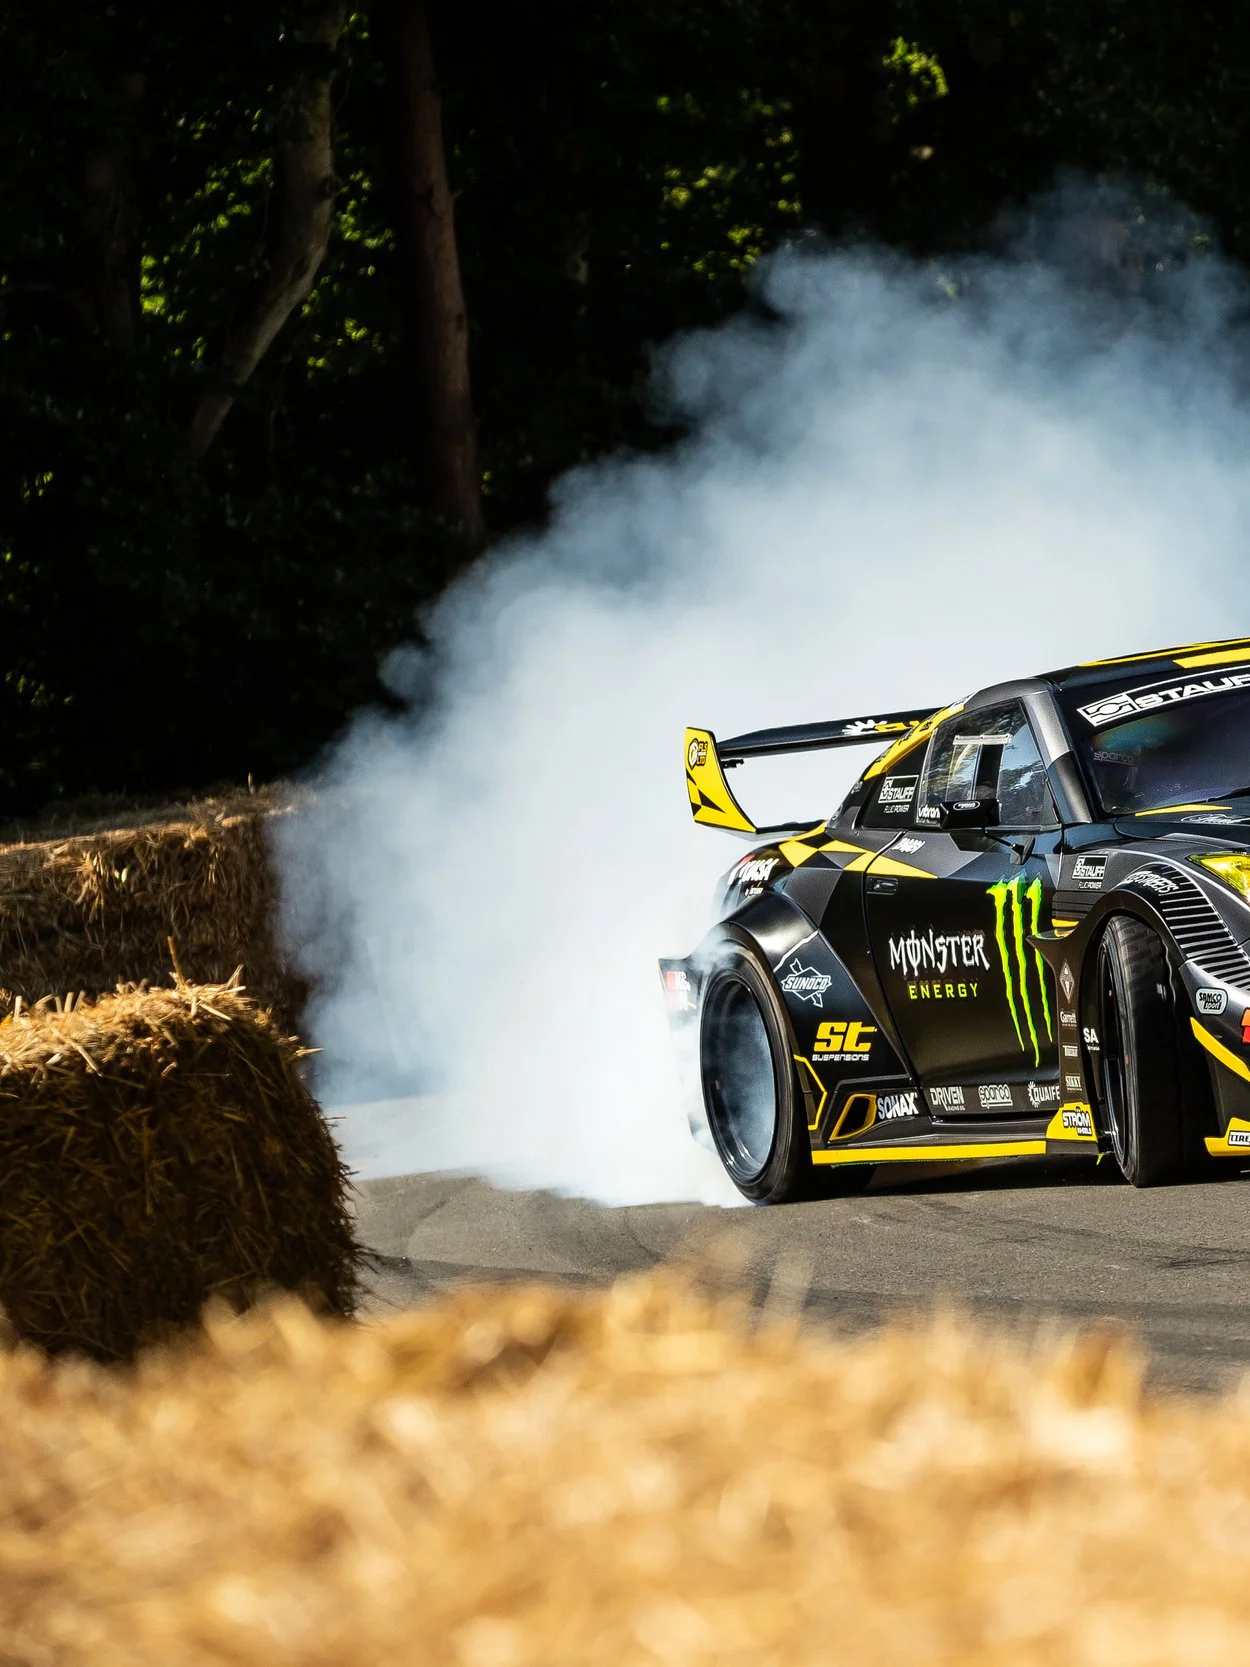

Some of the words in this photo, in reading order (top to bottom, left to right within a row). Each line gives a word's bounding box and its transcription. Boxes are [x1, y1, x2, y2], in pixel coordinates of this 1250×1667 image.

[887, 787, 915, 800] STAUFF
[918, 804, 940, 818] vibran
[1080, 865, 1105, 877] STAUFF
[784, 976, 828, 991] SUNOCO
[908, 983, 978, 999] ENERGY
[1199, 992, 1222, 1002] SAMCO
[811, 1053, 870, 1062] SUSPENSIONS
[930, 1086, 965, 1108] DRIVEN
[1031, 1084, 1060, 1102] QUAIFE
[877, 1092, 919, 1120] SONAX
